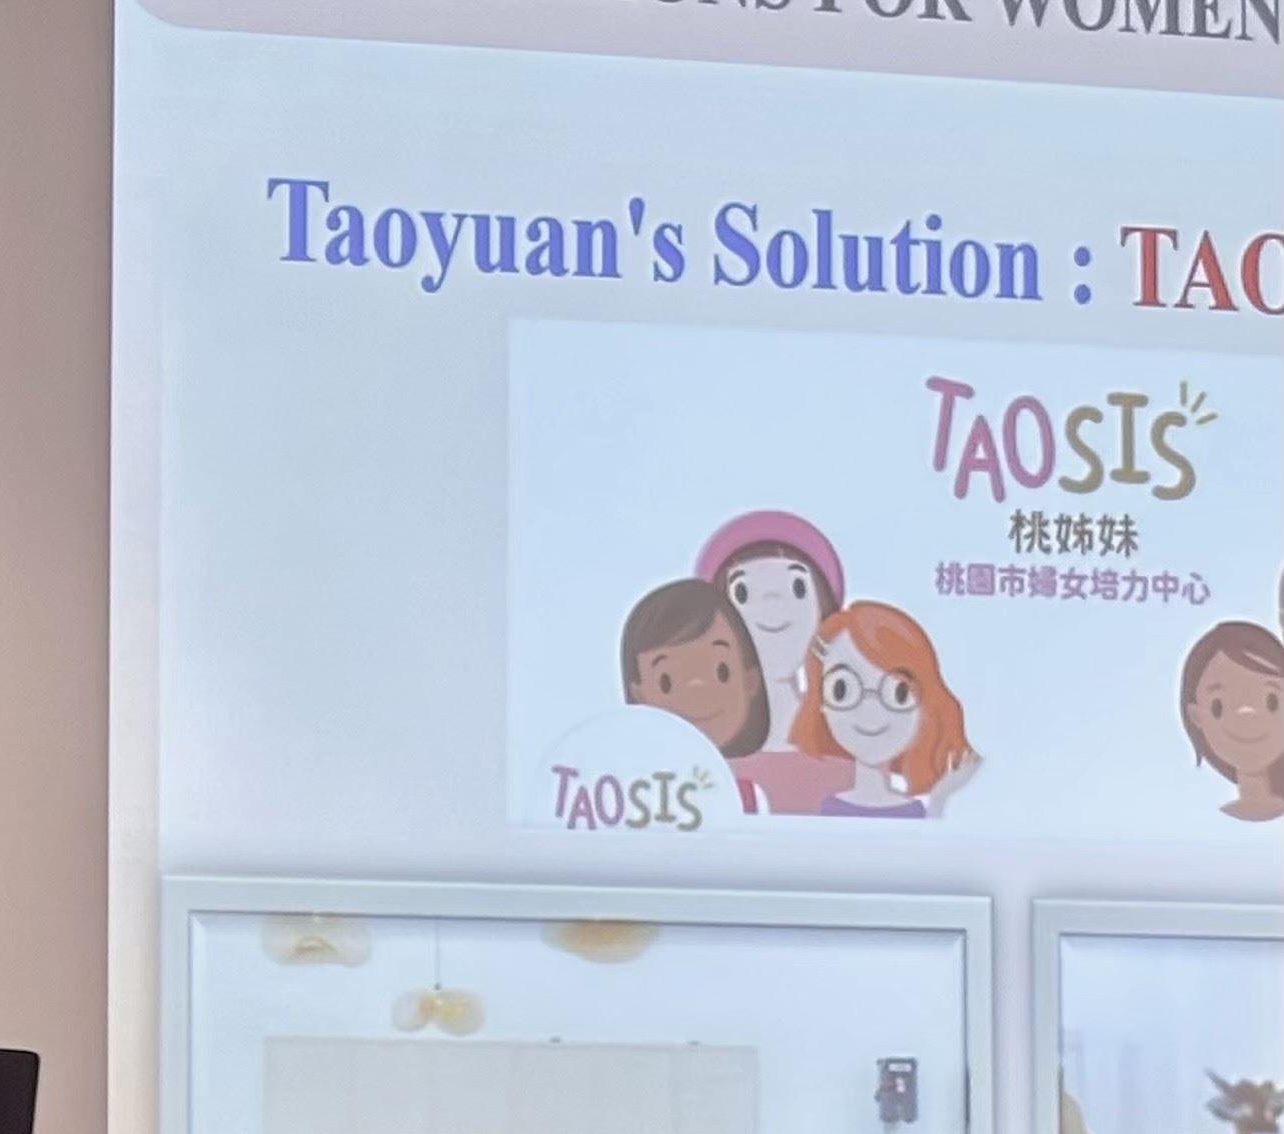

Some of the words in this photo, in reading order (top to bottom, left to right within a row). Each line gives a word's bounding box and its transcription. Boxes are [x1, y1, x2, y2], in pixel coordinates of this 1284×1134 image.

[266, 177, 685, 293] Taoyuan's
[713, 202, 1043, 301] Solution
[1120, 226, 1284, 316] TAO
[925, 376, 1197, 503] TAOSIS
[1008, 508, 1139, 558] 桃姊妹
[935, 561, 1211, 605] 桃園市婦女培力中心
[551, 764, 703, 832] TAOSIS
